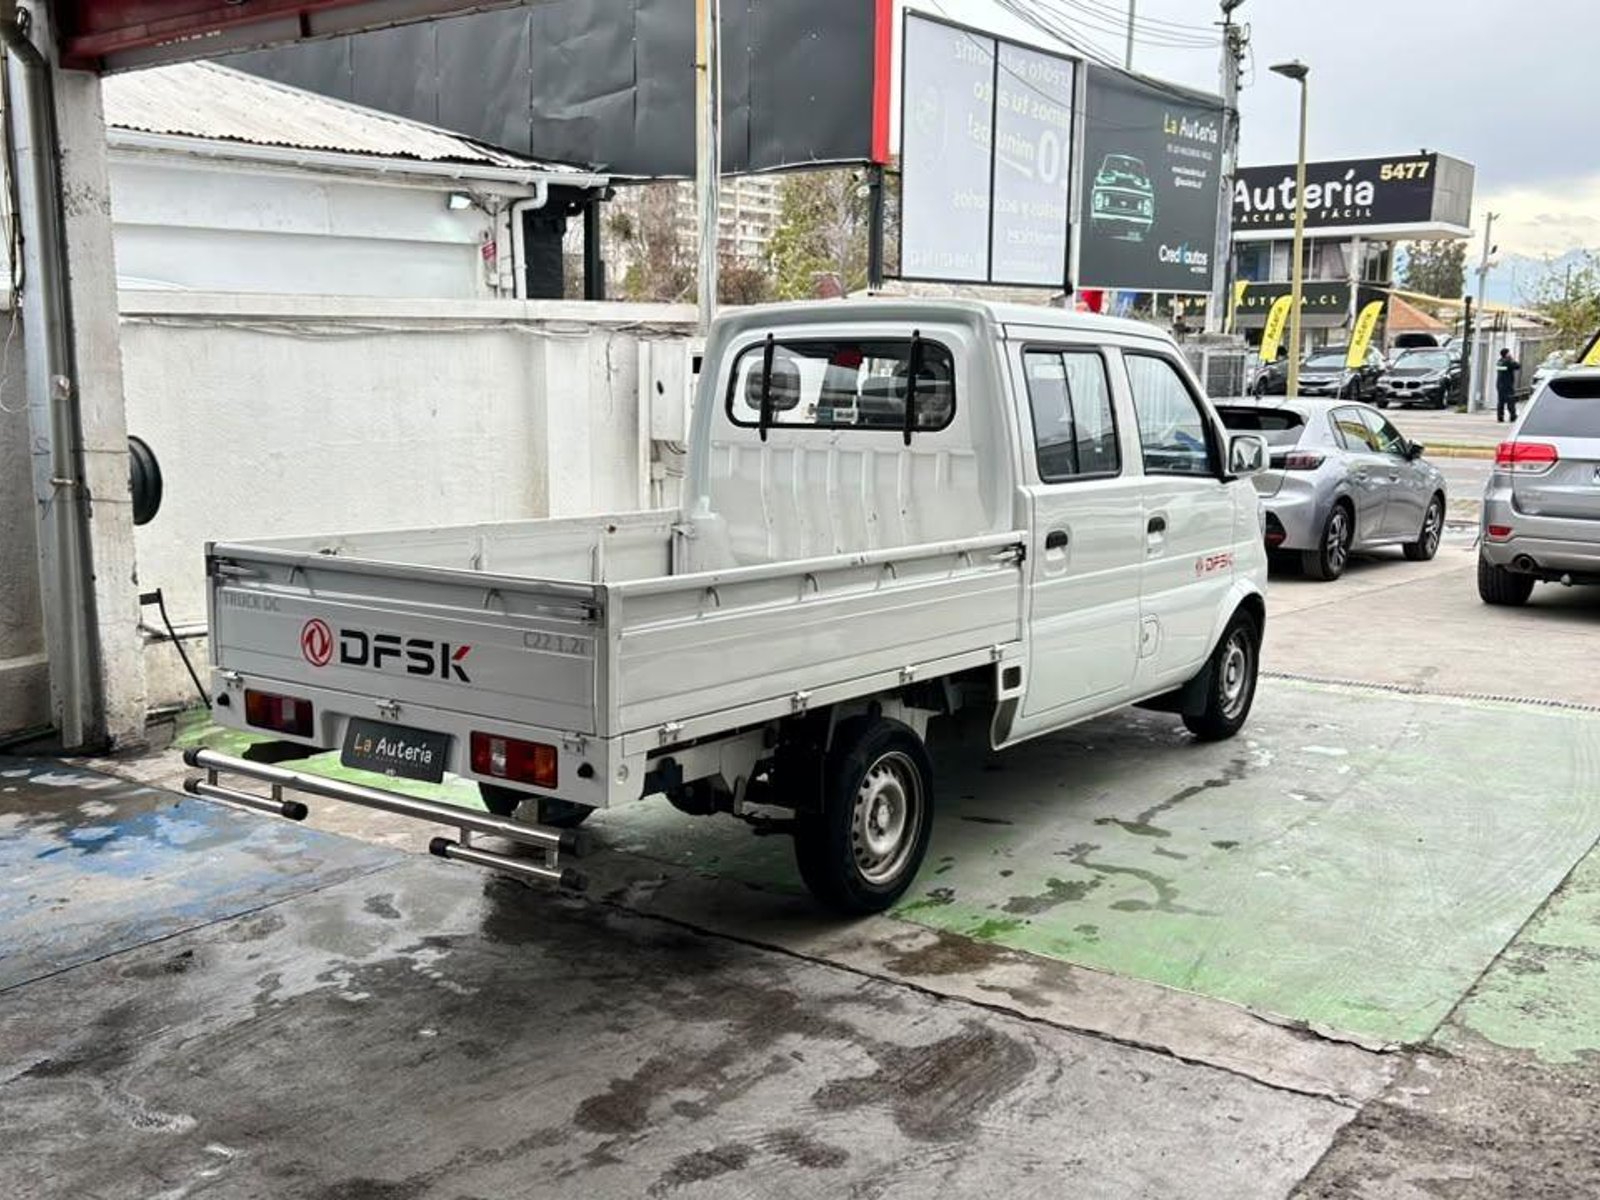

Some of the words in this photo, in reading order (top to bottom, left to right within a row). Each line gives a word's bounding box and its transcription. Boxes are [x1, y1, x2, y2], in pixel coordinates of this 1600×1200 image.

[1163, 112, 1177, 134] La
[1380, 162, 1430, 180] 5477
[1234, 169, 1375, 212] Autería
[340, 629, 471, 683] DFSK
[354, 733, 371, 752] La
[375, 737, 432, 763] Autería
